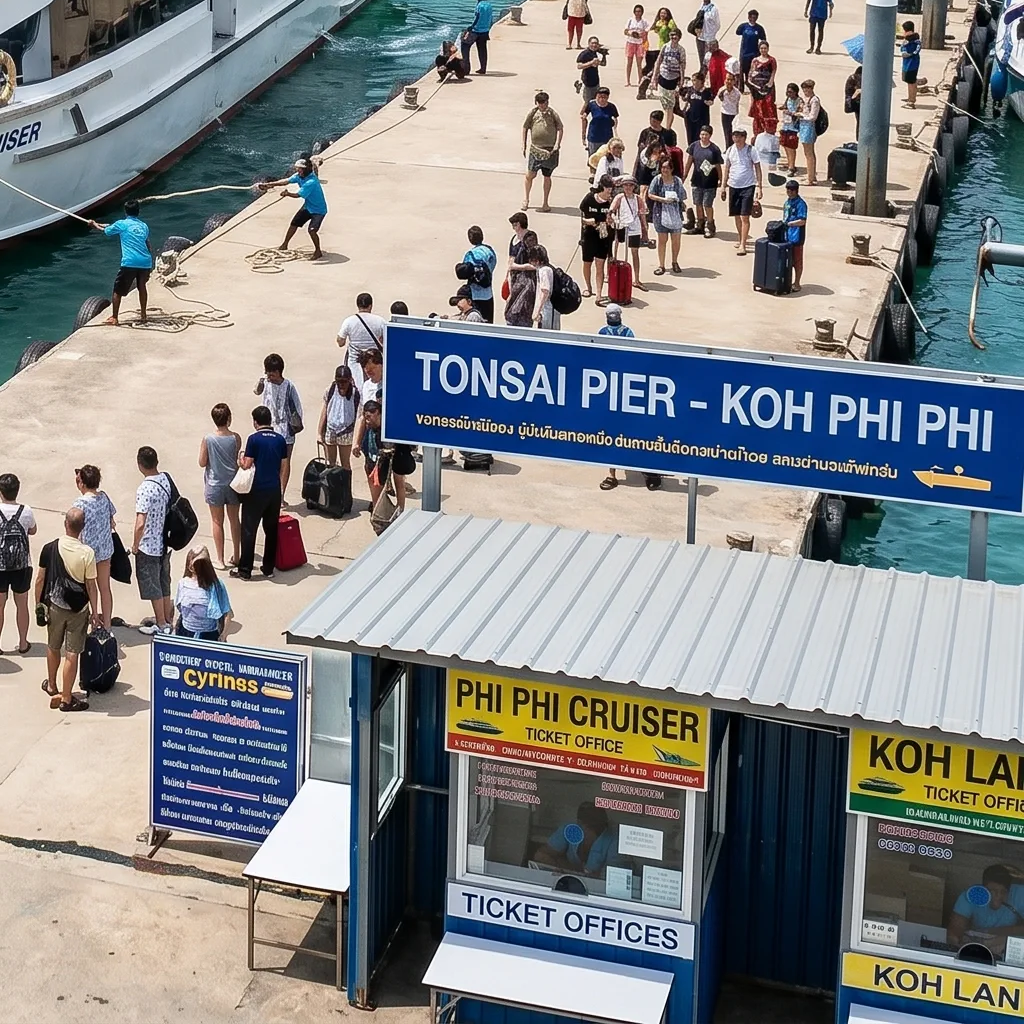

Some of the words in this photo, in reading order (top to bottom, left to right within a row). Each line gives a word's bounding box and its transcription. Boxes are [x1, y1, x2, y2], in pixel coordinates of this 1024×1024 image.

[414, 351, 567, 407] TONSAI
[581, 368, 676, 418] PIER
[721, 382, 814, 433] KOH
[828, 393, 903, 443] PHI
[917, 403, 994, 453] PHI
[456, 678, 502, 714] PHI
[512, 687, 560, 723] PHI
[569, 695, 700, 744] CRUISER
[525, 726, 572, 746] TICKET
[574, 734, 624, 754] OFFICE
[869, 734, 952, 780] KOH
[923, 784, 980, 806] TICKET
[461, 891, 557, 928] TICKET
[564, 911, 679, 950] OFFICES
[874, 964, 942, 997] KOH
